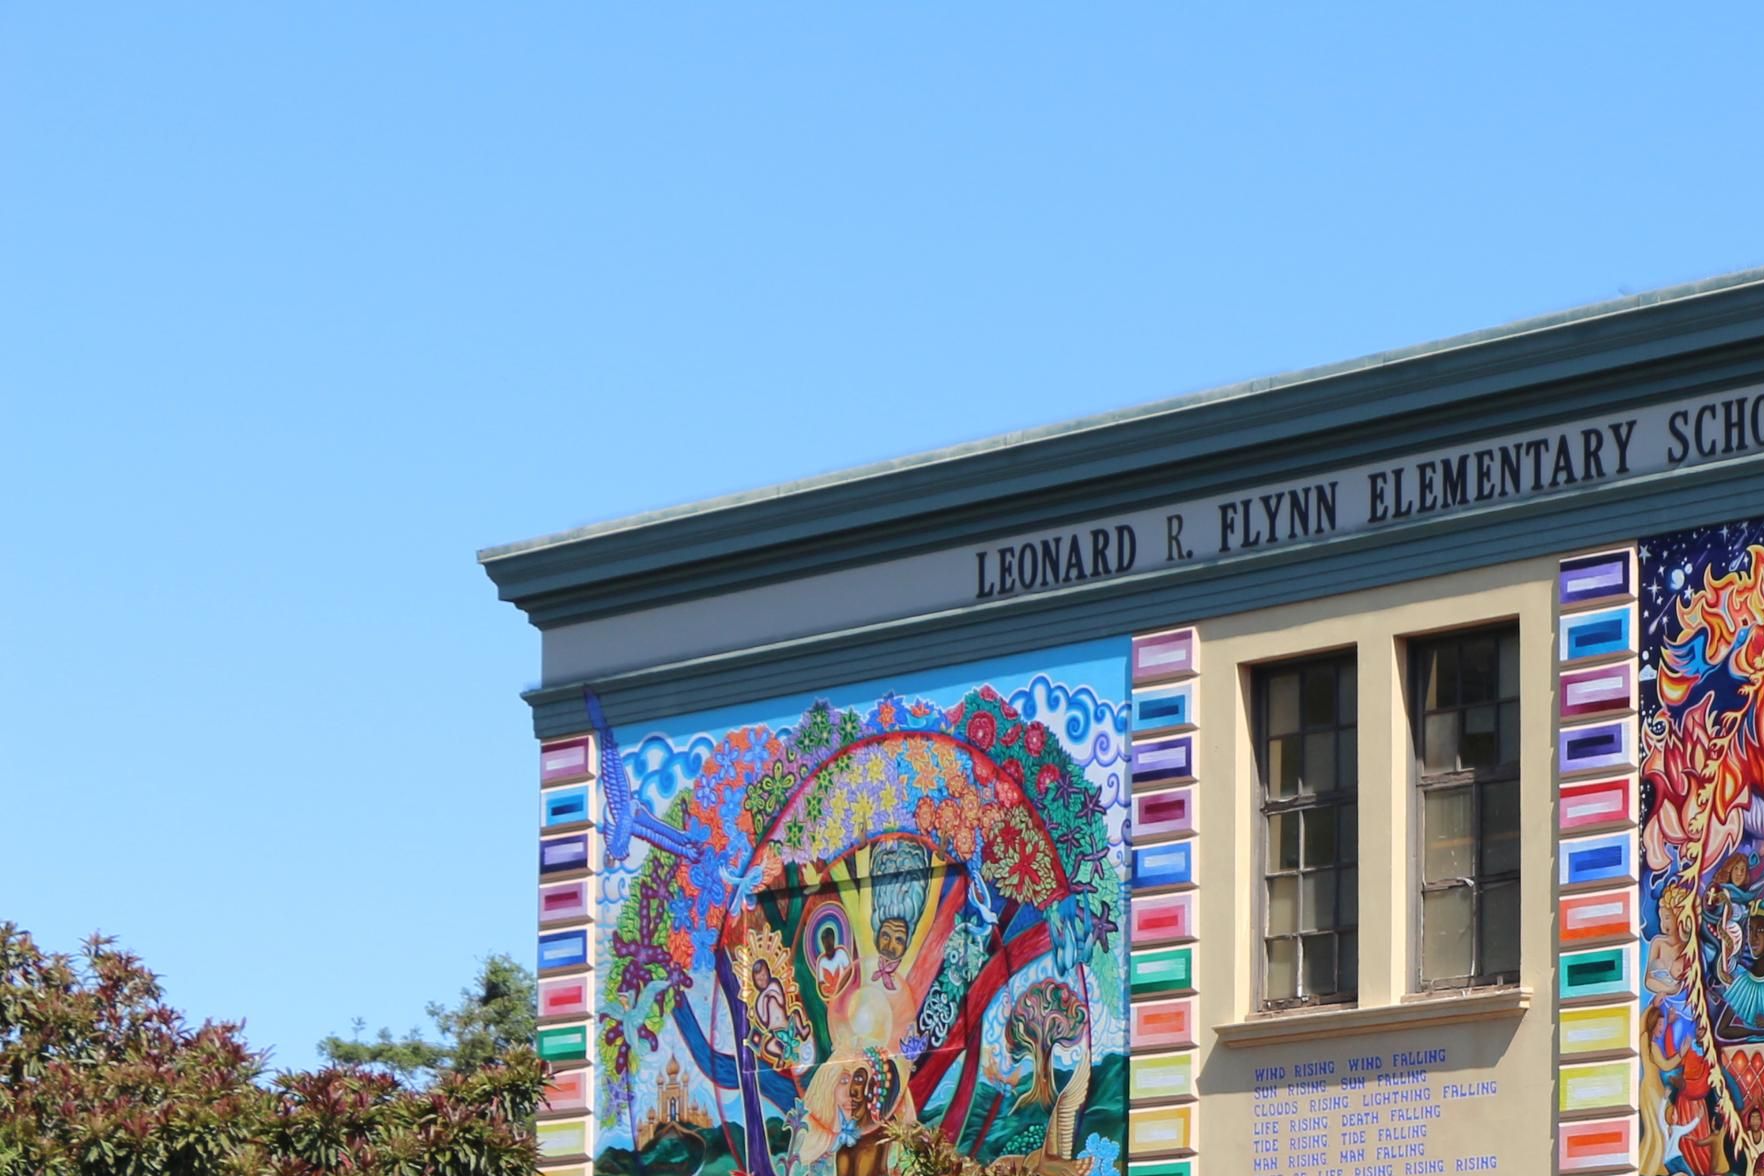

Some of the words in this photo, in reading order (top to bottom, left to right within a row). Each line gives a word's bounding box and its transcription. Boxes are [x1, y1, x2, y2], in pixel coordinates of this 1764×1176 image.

[975, 524, 1137, 599] LEONARD
[1166, 514, 1193, 561] R.
[1218, 481, 1339, 552] FLYNN
[1367, 420, 1638, 523] ELEMENTARY
[1255, 1068, 1285, 1082] WIND
[1294, 1061, 1335, 1077] RISING
[1348, 1056, 1382, 1071] WIND
[1392, 1049, 1446, 1067] FALLING
[1254, 1086, 1278, 1100] SUN
[1288, 1080, 1326, 1096] RISING
[1340, 1076, 1365, 1090] SUN
[1377, 1070, 1427, 1086] FALLING
[1254, 1101, 1298, 1117] CLOUDS
[1310, 1096, 1349, 1112] RISING
[1363, 1088, 1431, 1106] LIGHTNING
[1442, 1081, 1497, 1098] FALLING
[1254, 1121, 1279, 1135] LIFE
[1290, 1116, 1328, 1133] RISING
[1342, 1112, 1379, 1127] DEATH
[1390, 1105, 1441, 1122] FALLING
[1253, 1139, 1279, 1153] TIDE
[1290, 1134, 1328, 1150] RISING
[1341, 1131, 1366, 1145] TIDE
[1378, 1125, 1427, 1141] FALLING
[1254, 1158, 1278, 1172] MAN
[1288, 1153, 1327, 1168] RISING
[1340, 1149, 1365, 1163] MAN
[1376, 1144, 1425, 1160] FALLING
[1405, 1160, 1444, 1175] RISING
[1456, 1156, 1497, 1172] RISING
